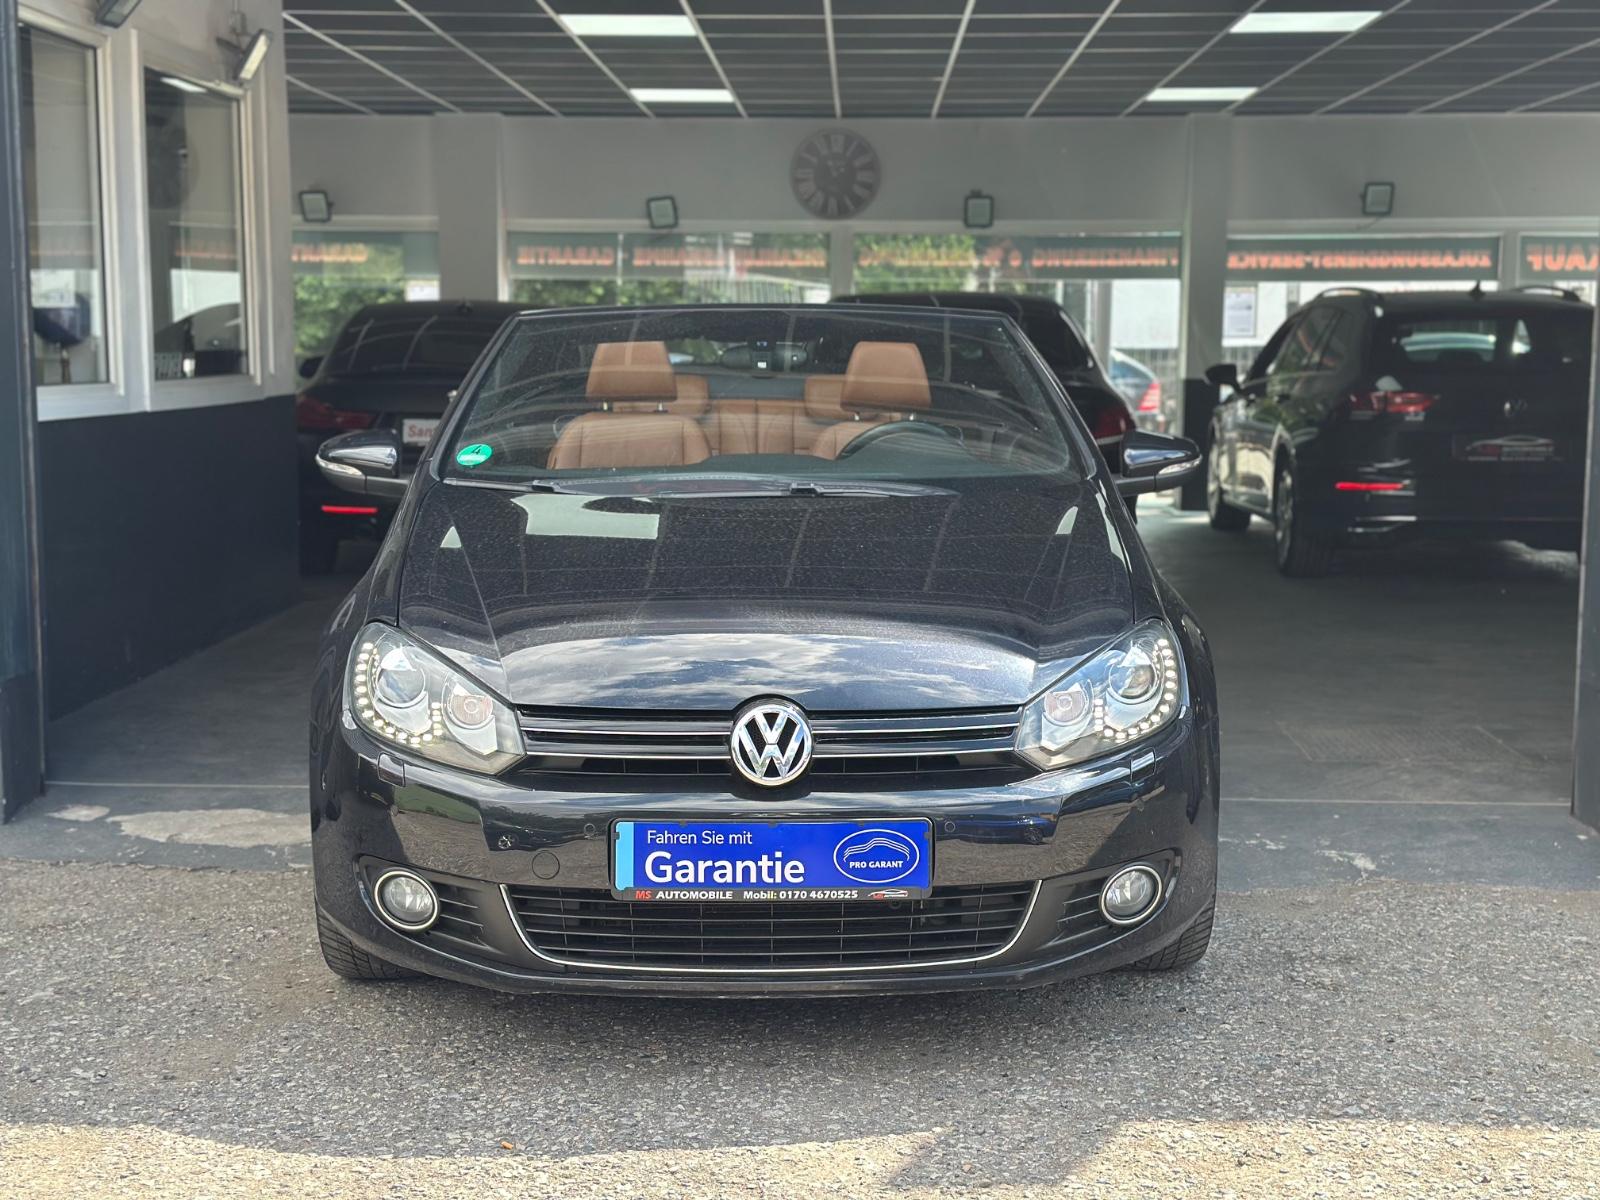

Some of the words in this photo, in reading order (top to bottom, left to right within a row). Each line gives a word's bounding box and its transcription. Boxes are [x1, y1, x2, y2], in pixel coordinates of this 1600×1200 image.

[647, 830, 697, 844] Fahren
[702, 830, 724, 844] Sie
[729, 830, 753, 844] mit
[644, 851, 806, 884] Garantie
[849, 860, 867, 869] PRO
[868, 860, 904, 869] GARANT
[635, 890, 652, 899] MS
[656, 890, 733, 899] AUTOMOBILE
[743, 890, 778, 899] Mobil:
[779, 890, 808, 899] 0170
[810, 890, 859, 899] 4670525
